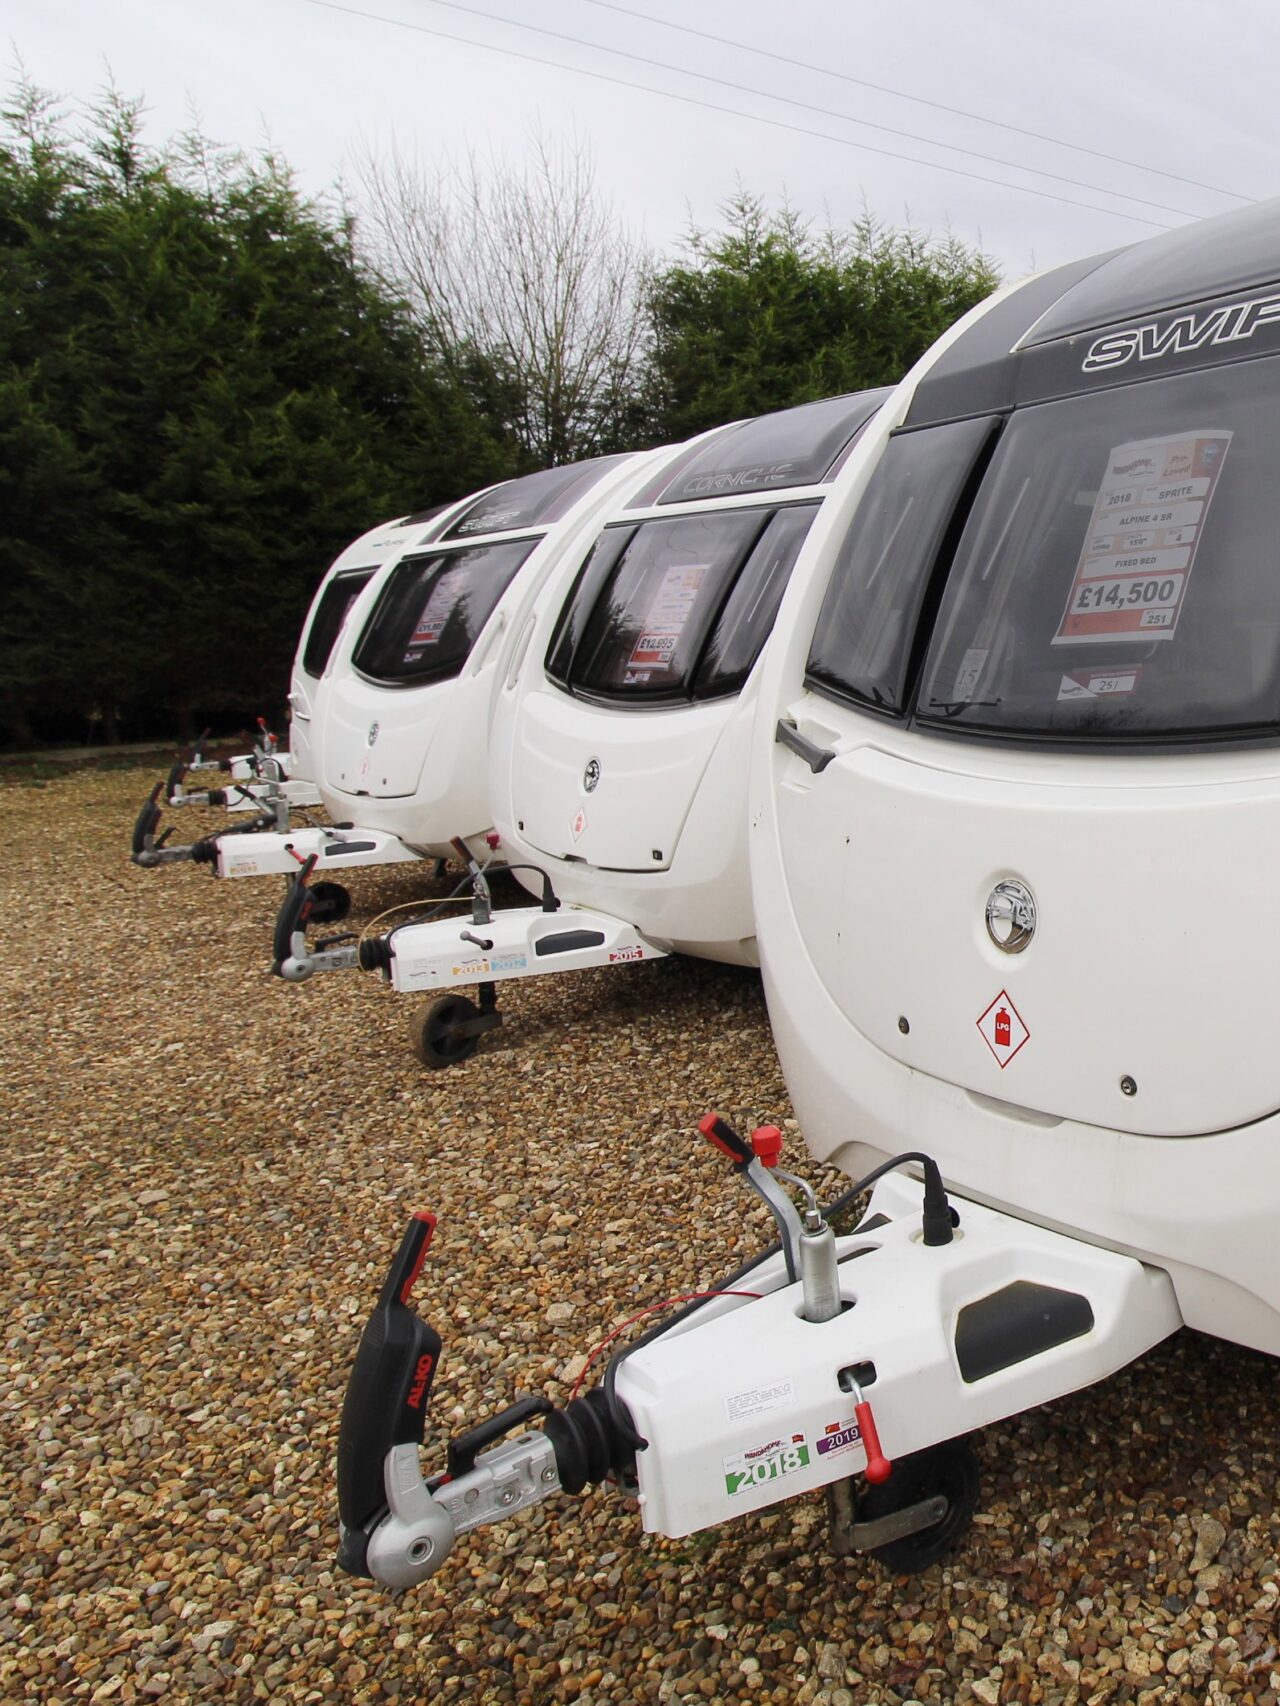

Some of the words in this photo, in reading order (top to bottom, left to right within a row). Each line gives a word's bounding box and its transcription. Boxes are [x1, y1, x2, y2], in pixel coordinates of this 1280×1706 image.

[1107, 493, 1132, 506] 2018
[1158, 486, 1193, 500] SPRITE
[1119, 514, 1151, 526] ALPINE
[1160, 512, 1173, 521] SR
[1115, 558, 1138, 568] FIXED
[1139, 556, 1157, 566] BED
[1077, 579, 1175, 609] £14,500
[1146, 614, 1167, 625] 251
[996, 1022, 1010, 1031] LPG
[407, 1354, 433, 1409] AL-KO
[828, 1427, 859, 1450] 2019
[733, 1449, 803, 1493] 2018
